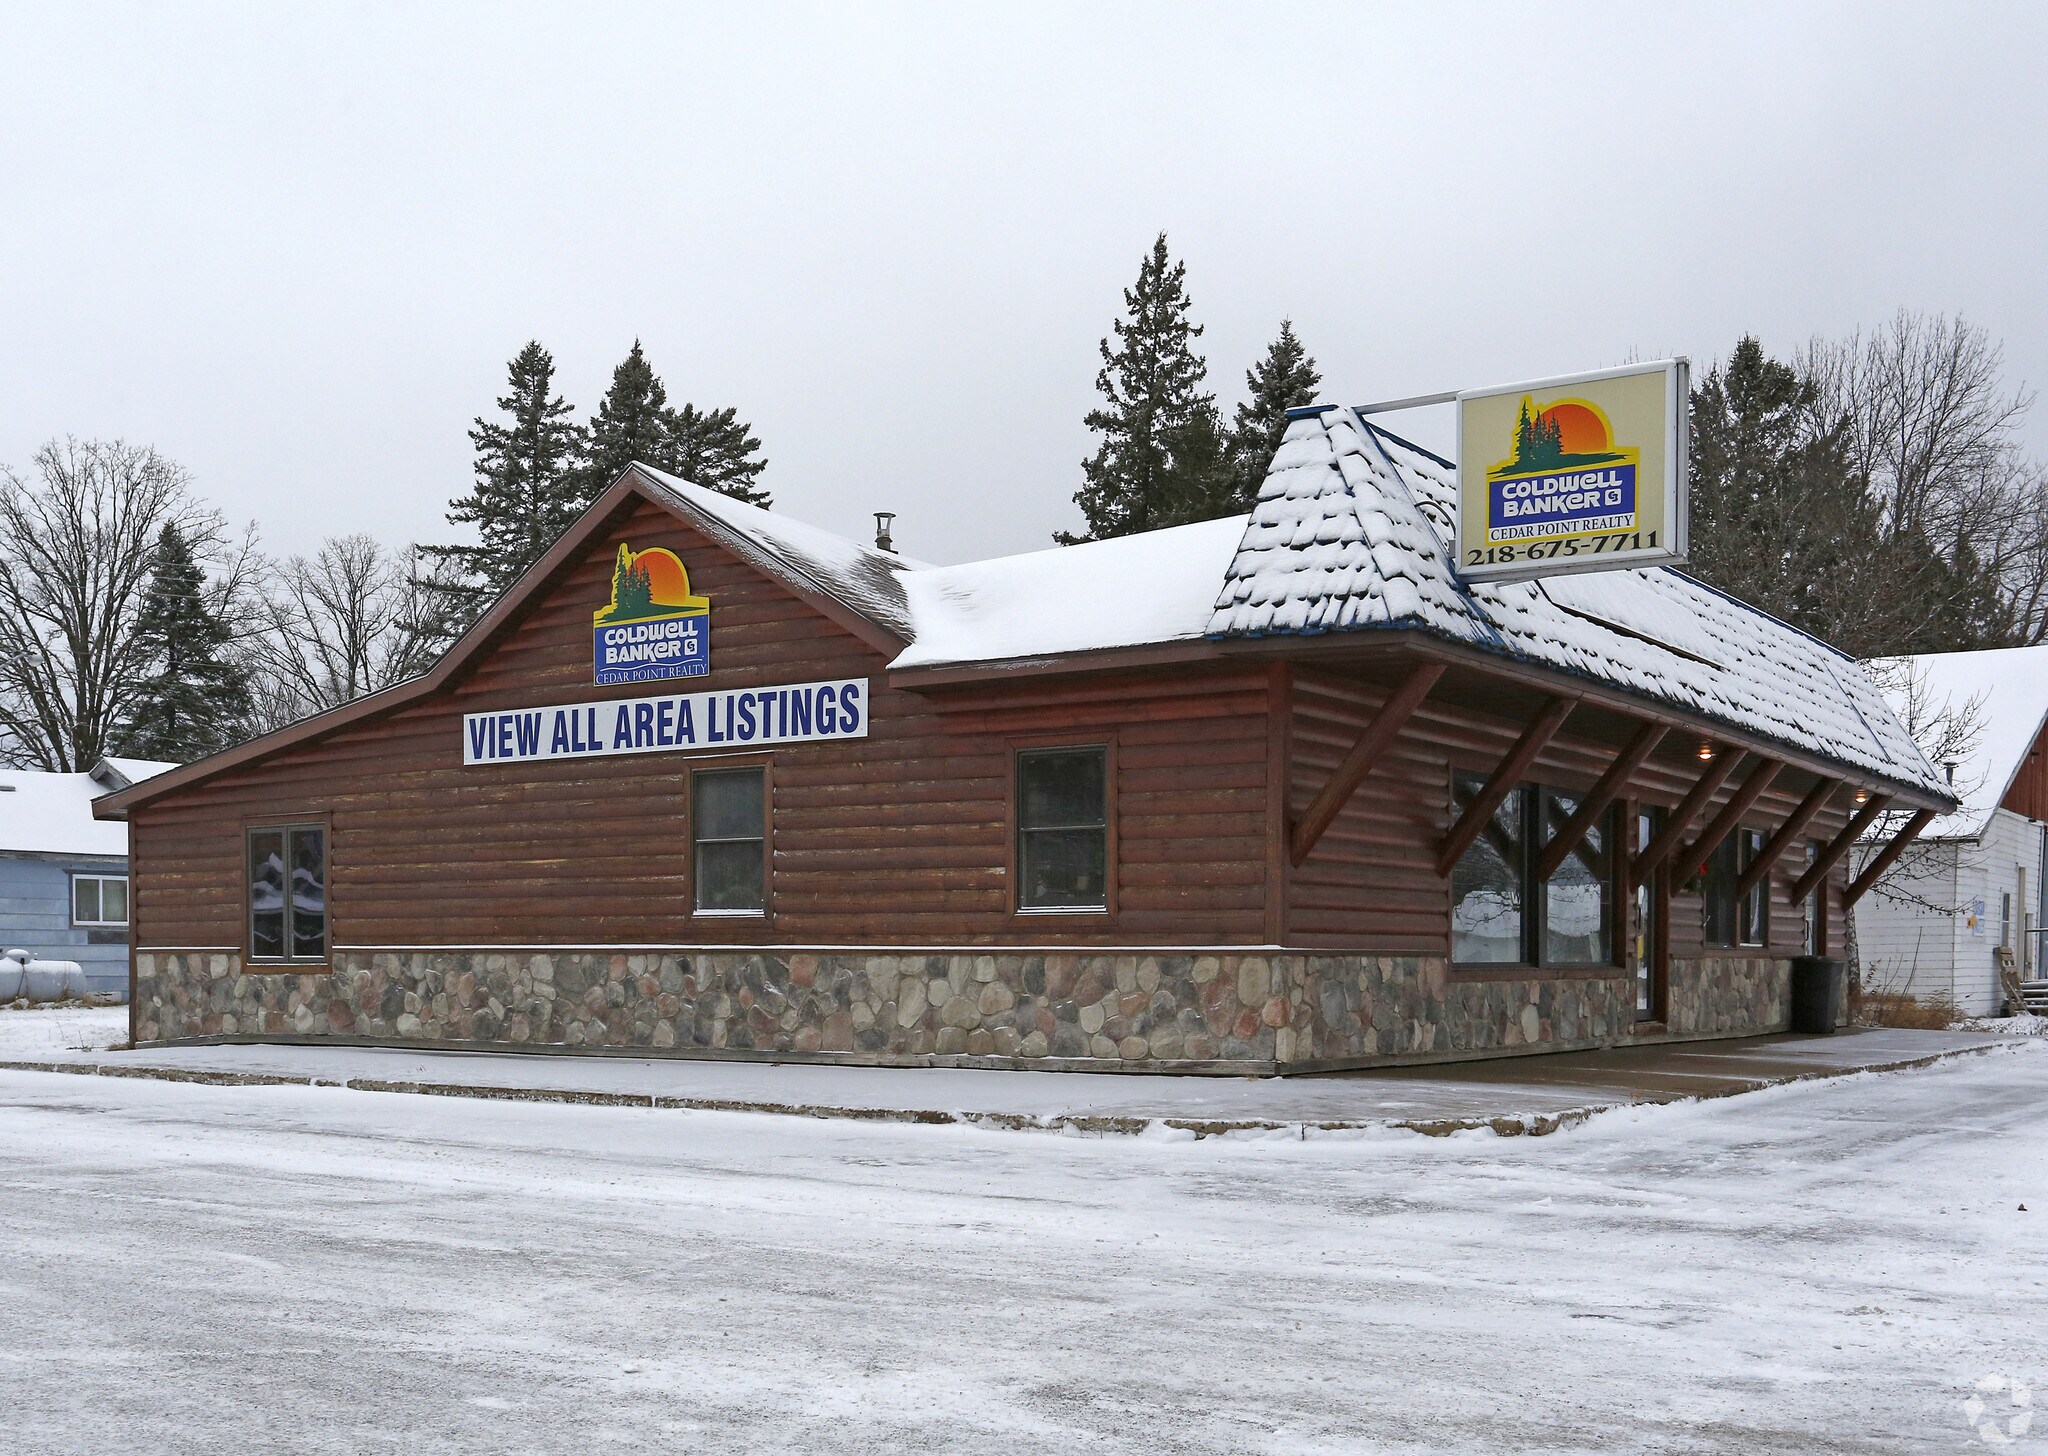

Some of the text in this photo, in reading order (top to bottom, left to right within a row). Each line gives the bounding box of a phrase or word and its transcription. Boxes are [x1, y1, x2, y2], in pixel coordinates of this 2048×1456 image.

[1502, 470, 1623, 499] COLDWELL
[1503, 491, 1601, 518] BANKER
[1491, 514, 1633, 541] CEDAR POINT REALTY
[1467, 530, 1658, 566] 218-675-7711
[604, 620, 698, 645] COLDWELL
[605, 640, 681, 664] BANKER
[595, 663, 707, 685] CEDAR POINT REALTY
[469, 683, 860, 760] VIEW ALL AREA LISTINGS
